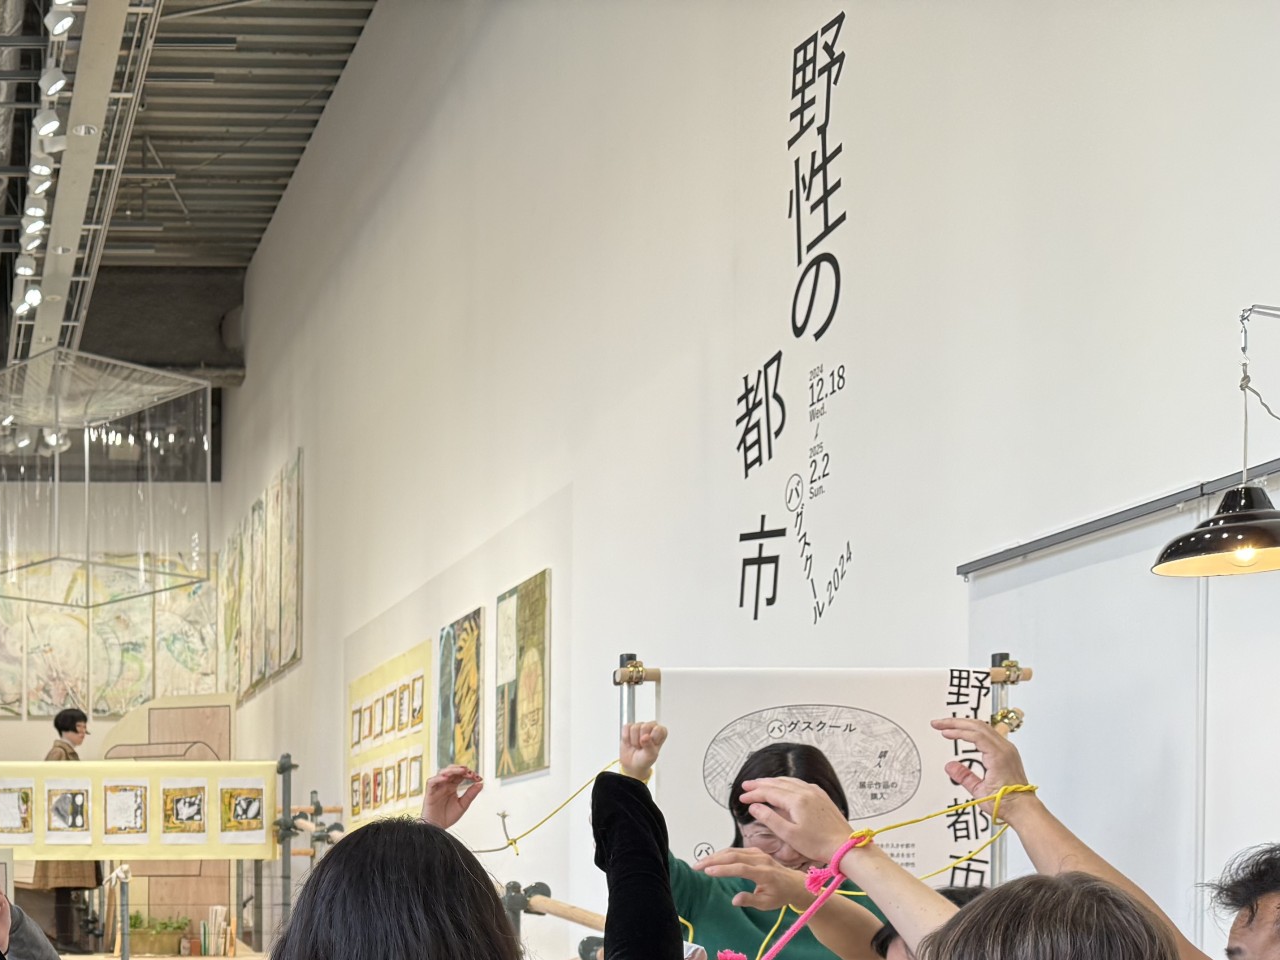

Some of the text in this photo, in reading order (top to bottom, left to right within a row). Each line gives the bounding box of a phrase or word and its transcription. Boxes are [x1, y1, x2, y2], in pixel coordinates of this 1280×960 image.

[787, 11, 847, 342] 野性の
[809, 363, 824, 381] 2024
[809, 364, 846, 408] 12.18
[809, 402, 827, 422] Wed.
[809, 441, 824, 459] 2025
[809, 452, 830, 485] 2.2
[736, 349, 787, 621] 都市
[809, 485, 826, 500] Sun.
[785, 473, 853, 625] バグスクール 2024
[767, 719, 857, 738] バグスクール
